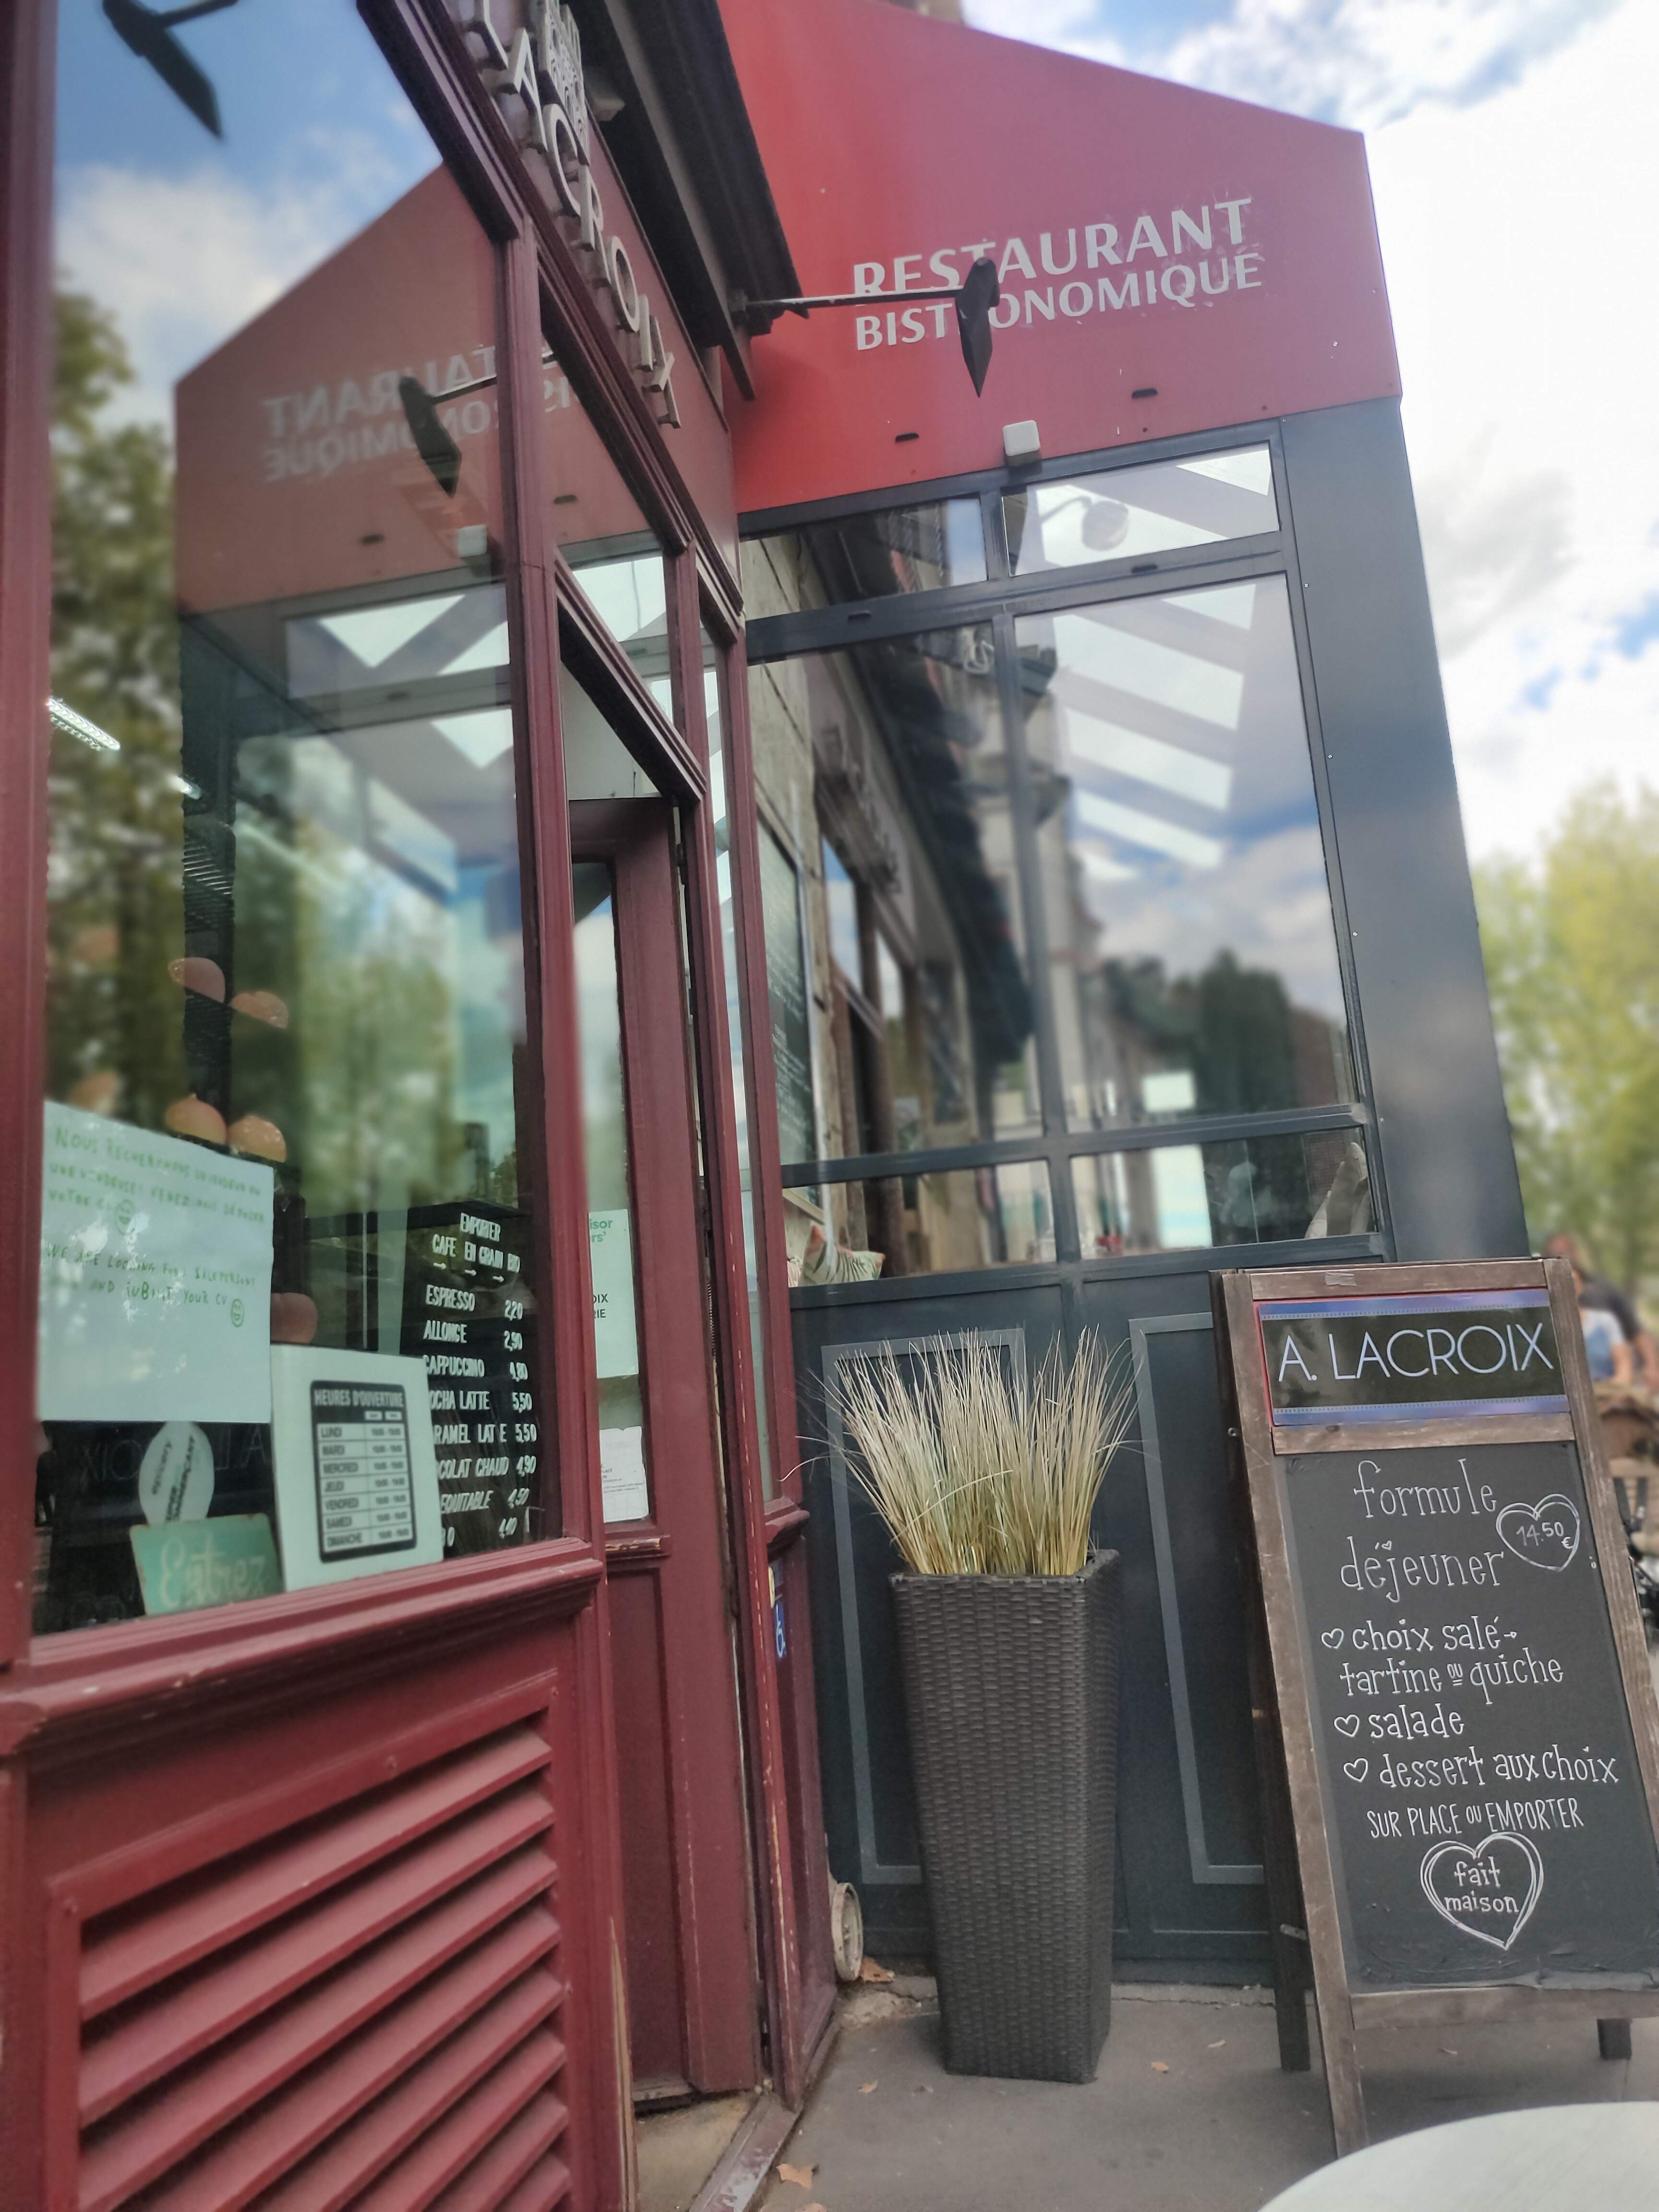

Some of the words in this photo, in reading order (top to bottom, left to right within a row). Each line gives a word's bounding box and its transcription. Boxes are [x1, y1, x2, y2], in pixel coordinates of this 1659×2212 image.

[855, 252, 1262, 350] BISTONOMIQUE
[433, 1234, 457, 1257] CAFE
[464, 1241, 476, 1262] EN
[184, 1288, 209, 1304] YOUR
[426, 1284, 476, 1311] ESPRESSO
[423, 1320, 468, 1344] ALLONGE
[422, 1355, 485, 1377] CAPPUCCINO
[1278, 1334, 1317, 1382] A.
[1328, 1322, 1554, 1381] LACROIX
[314, 1389, 351, 1406] HEURES
[430, 1390, 456, 1410] OCHA
[459, 1390, 490, 1410] LATTE
[433, 1424, 471, 1445] RAMEL
[437, 1458, 472, 1480] COLAT
[475, 1456, 509, 1477] CHAUD
[1353, 1458, 1497, 1518] formule
[440, 1490, 494, 1515] EQUITABLE
[1341, 1536, 1504, 1603] déjeuner
[1352, 1619, 1434, 1652] choix
[1443, 1615, 1501, 1650] salé
[1340, 1658, 1442, 1696] tartine
[1470, 1647, 1564, 1704] quiche
[1369, 1703, 1465, 1740] salade
[1379, 1746, 1486, 1788] dessert
[1492, 1752, 1539, 1781] aux
[1367, 1809, 1402, 1838] SUR
[1407, 1803, 1462, 1836] PLACE
[1486, 1797, 1584, 1833] EMPORTER
[1454, 1856, 1501, 1887] fait
[1444, 1890, 1519, 1913] maison
